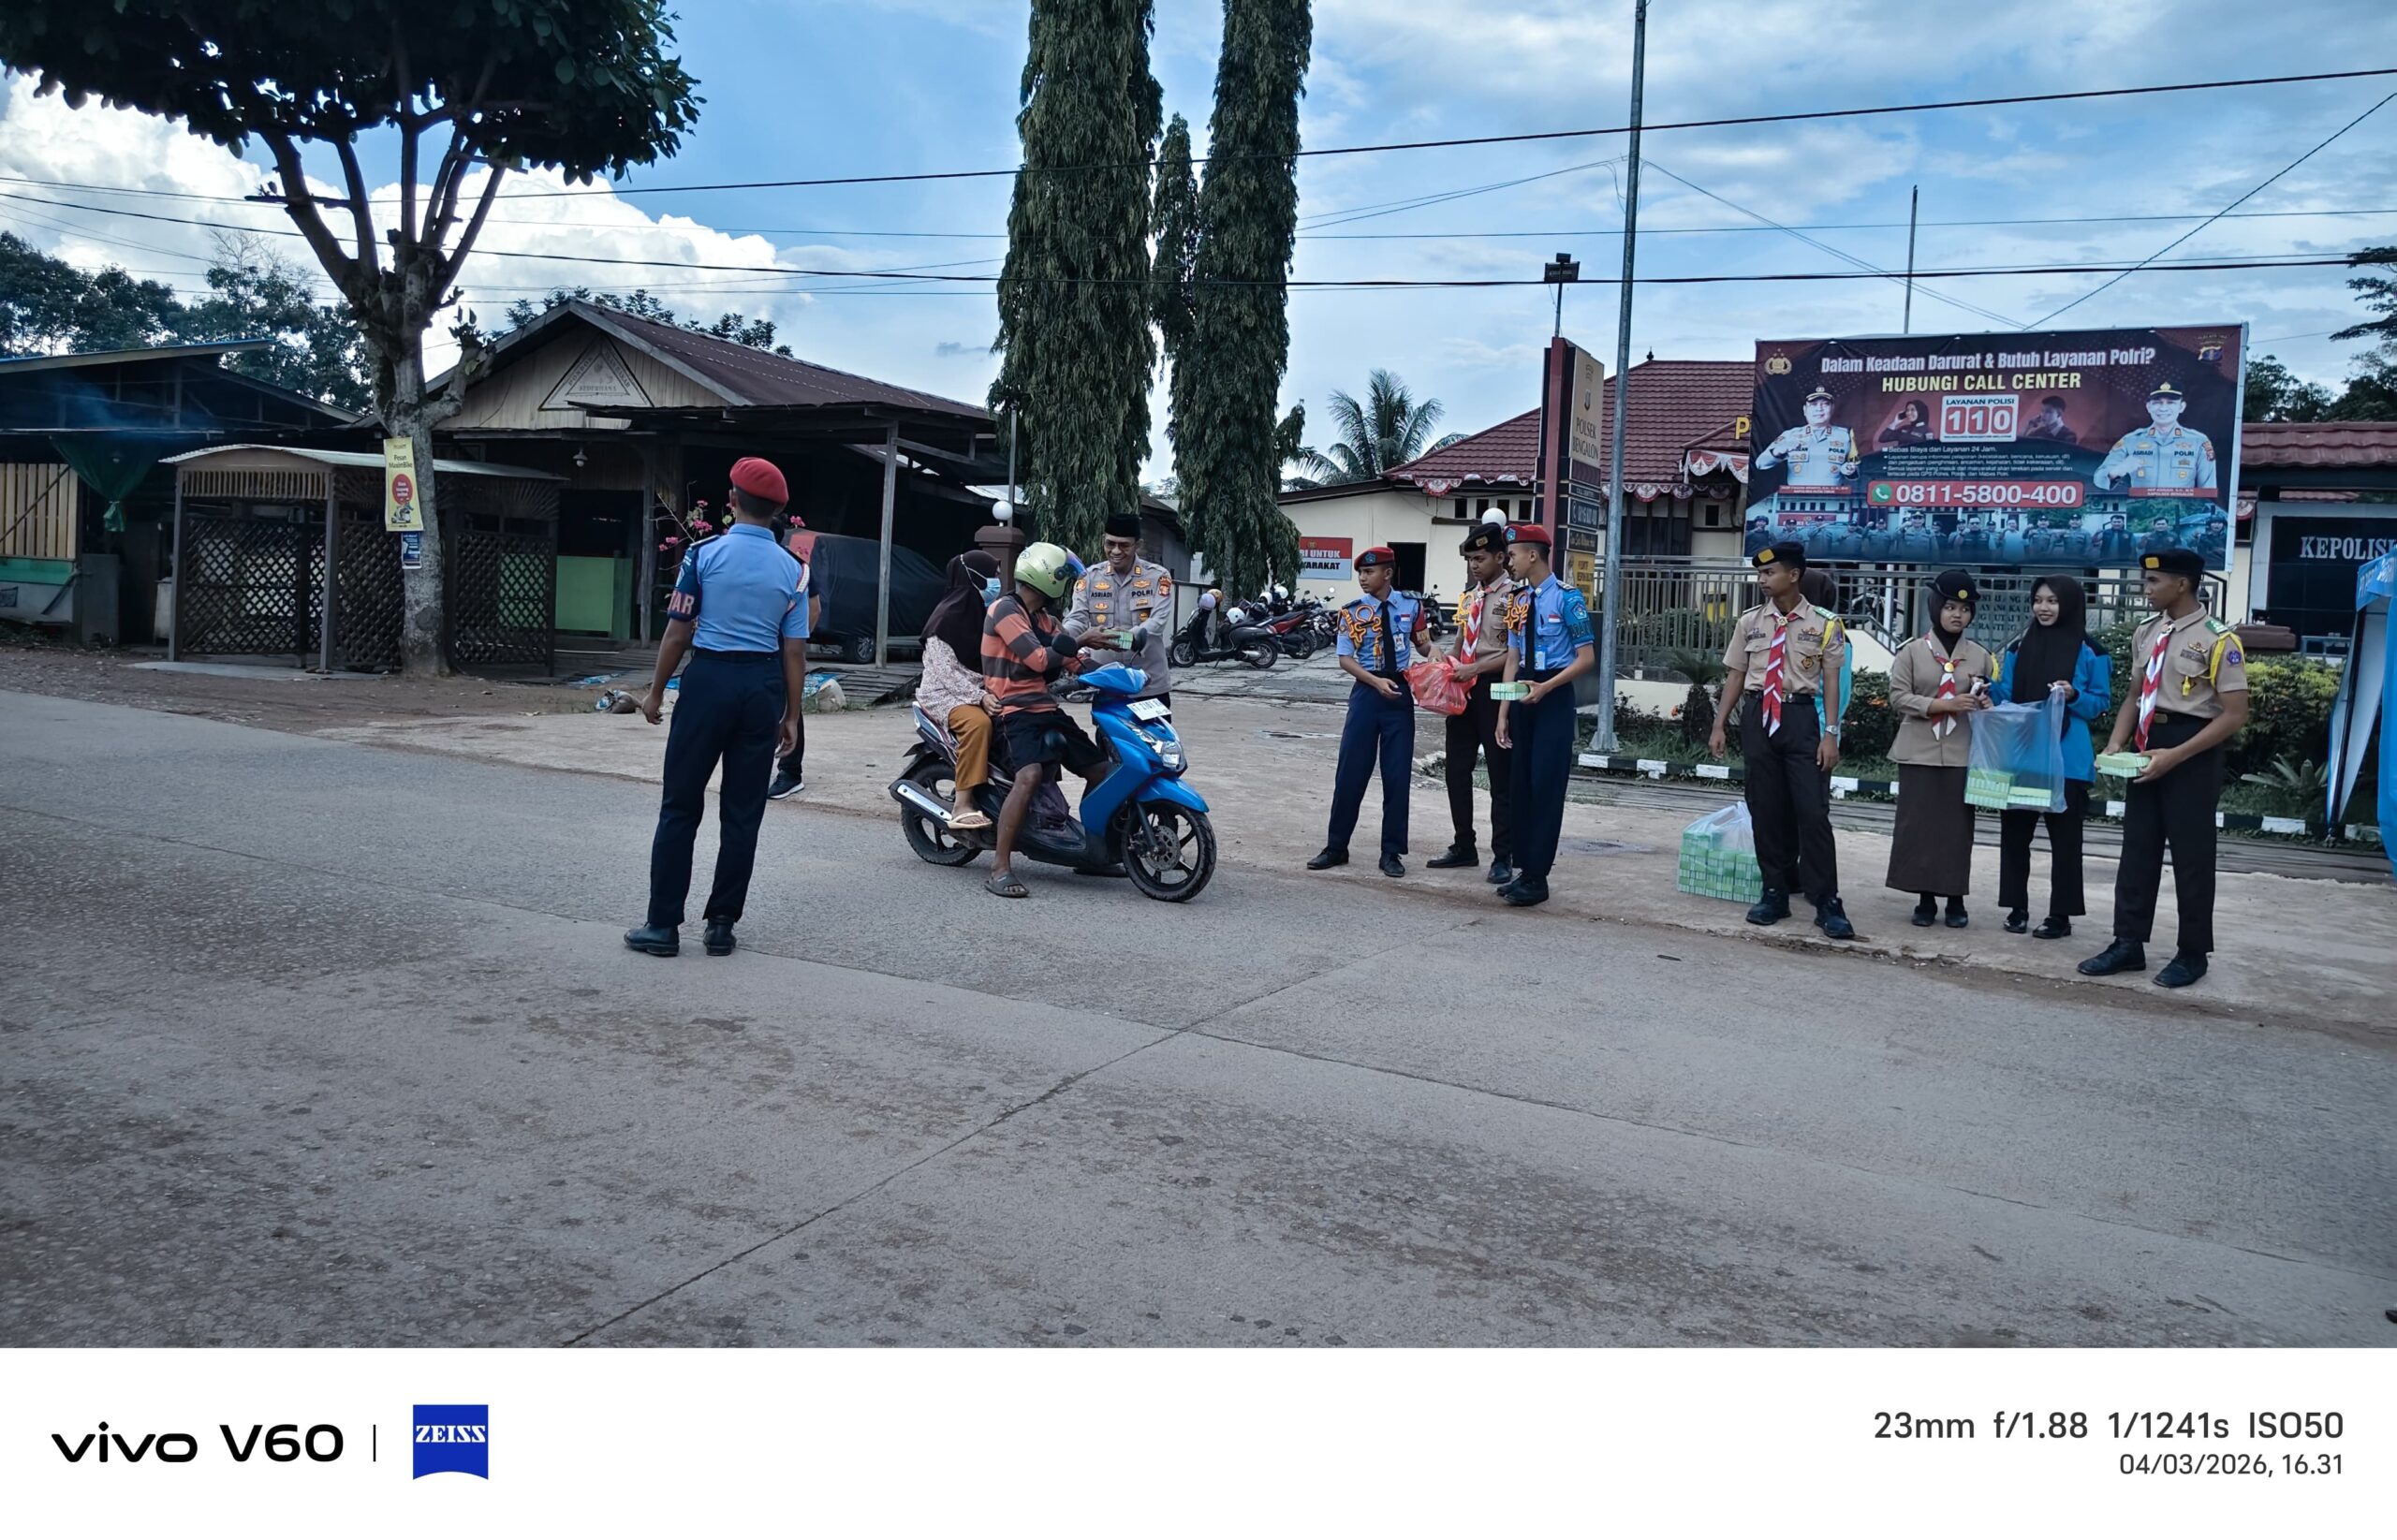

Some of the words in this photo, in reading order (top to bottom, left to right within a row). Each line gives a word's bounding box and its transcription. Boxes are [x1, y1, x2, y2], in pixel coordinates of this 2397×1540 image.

[1821, 357, 1862, 373] Dalam
[1866, 356, 1925, 372] Keadaan
[1928, 353, 1980, 371] Darurat
[1984, 353, 1994, 369] &
[1997, 352, 2040, 369] Butuh
[2043, 350, 2106, 369] Layanan
[2110, 347, 2155, 365] Polri?
[1882, 375, 1958, 392] HUBUNGI
[1963, 374, 2006, 390] CALL
[2012, 373, 2081, 390] CENTER
[1576, 417, 1596, 440] POLSEK
[1948, 409, 2011, 432] 110
[1572, 436, 1599, 461] BENGALON
[1910, 446, 1928, 454] Biaya
[1943, 446, 1971, 454] Layanan
[1896, 484, 2077, 504] 0811-5800-400
[1310, 550, 1341, 558] UNTUK
